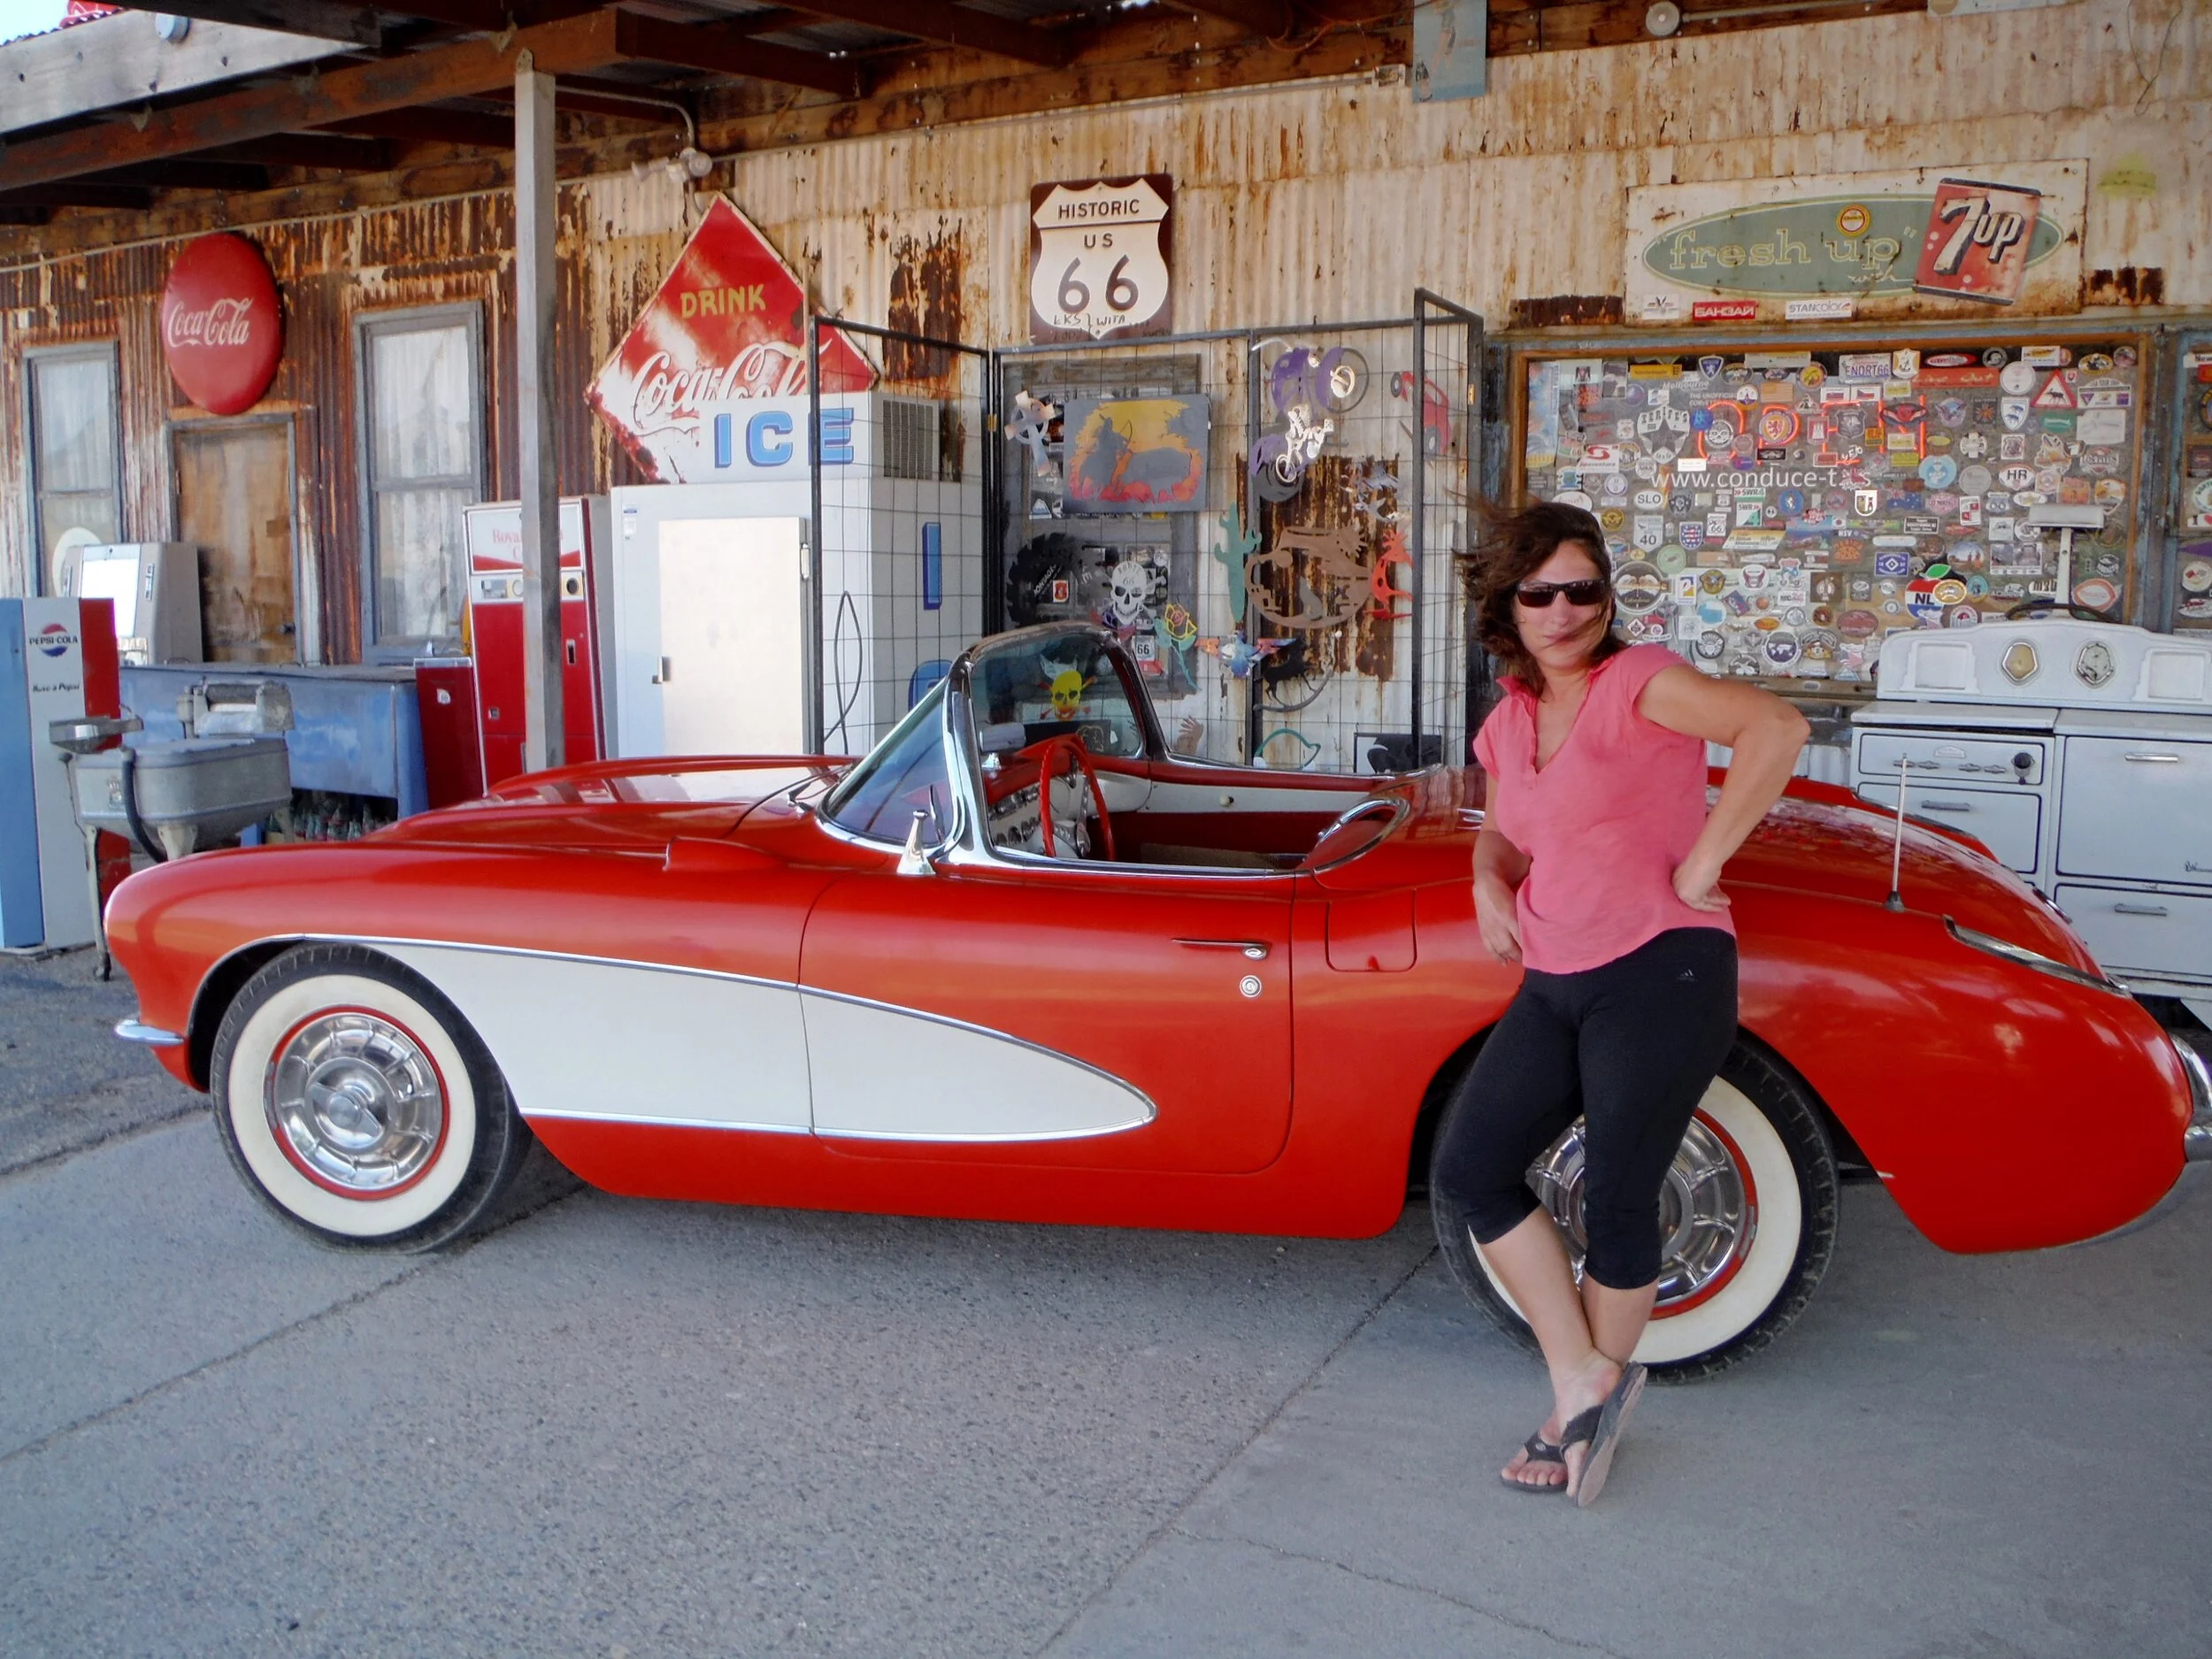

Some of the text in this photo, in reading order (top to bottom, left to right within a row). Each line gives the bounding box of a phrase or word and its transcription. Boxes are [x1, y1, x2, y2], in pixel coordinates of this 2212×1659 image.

[1057, 199, 1141, 219] HISTORIC
[1083, 233, 1114, 249] US
[1057, 254, 1140, 314] 66
[680, 284, 767, 319] DRINK
[167, 296, 254, 349] Coca-Cola
[630, 340, 833, 438] Coca-Col
[713, 406, 855, 469] ICE
[2007, 470, 2028, 481] HR
[1637, 494, 1662, 504] SLO
[1639, 534, 1657, 546] 40
[1914, 593, 1935, 605] NL
[1137, 643, 1150, 656] 66
